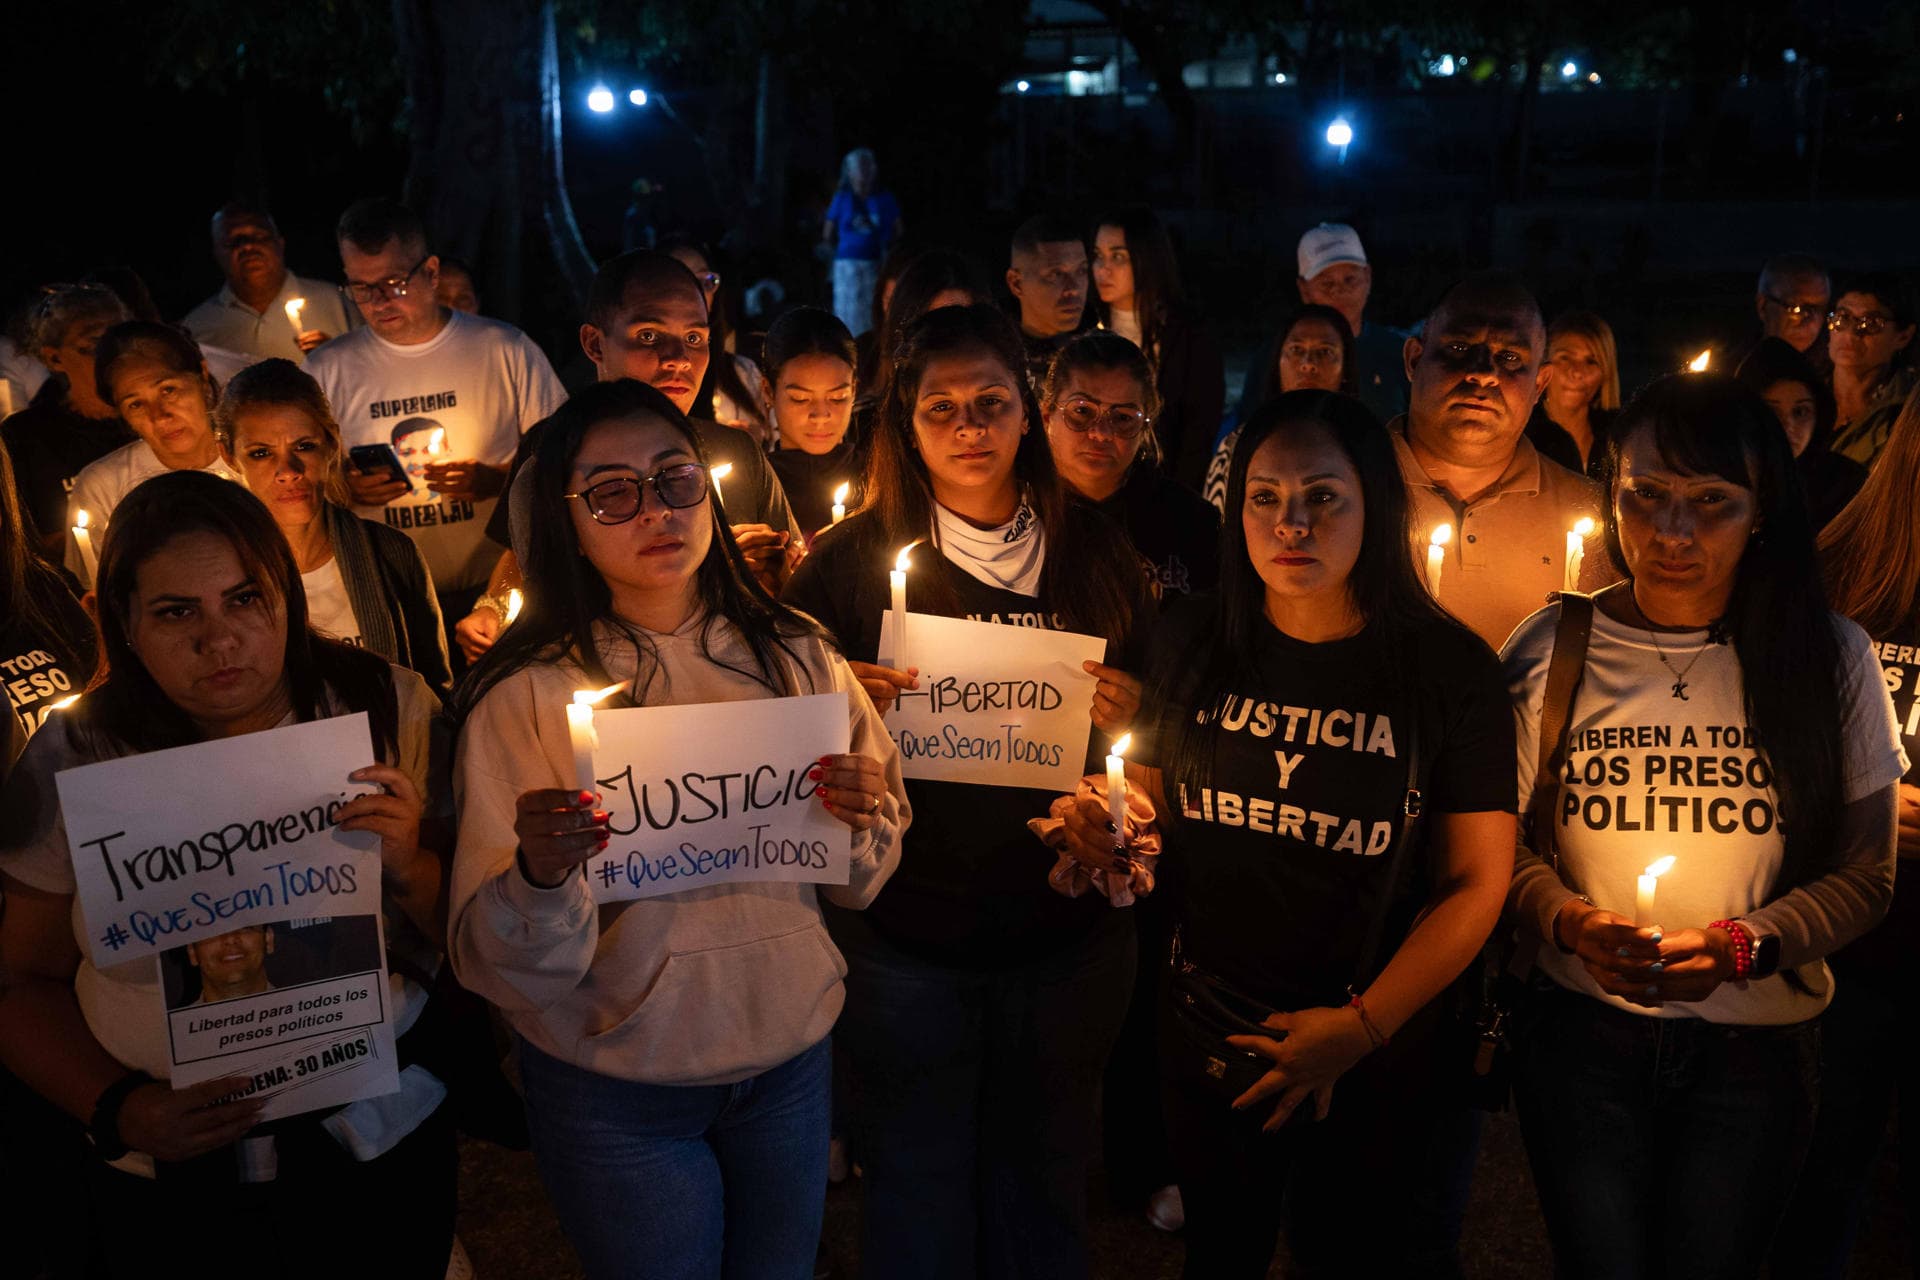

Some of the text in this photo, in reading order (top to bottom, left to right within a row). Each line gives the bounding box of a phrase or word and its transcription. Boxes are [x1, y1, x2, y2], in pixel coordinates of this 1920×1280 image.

[8, 668, 71, 708] ESO
[1568, 725, 1671, 752] LIBEREN
[1680, 726, 1698, 748] A
[1274, 751, 1305, 789] Y
[1565, 756, 1630, 786] LOS
[1178, 783, 1392, 856] LIBERTAD
[80, 792, 366, 901] Transparenc
[188, 988, 368, 1033] Libertad para todos los
[219, 1010, 343, 1048] presos políticos
[295, 1055, 318, 1076] 30
[323, 1038, 368, 1068] AÑOS
